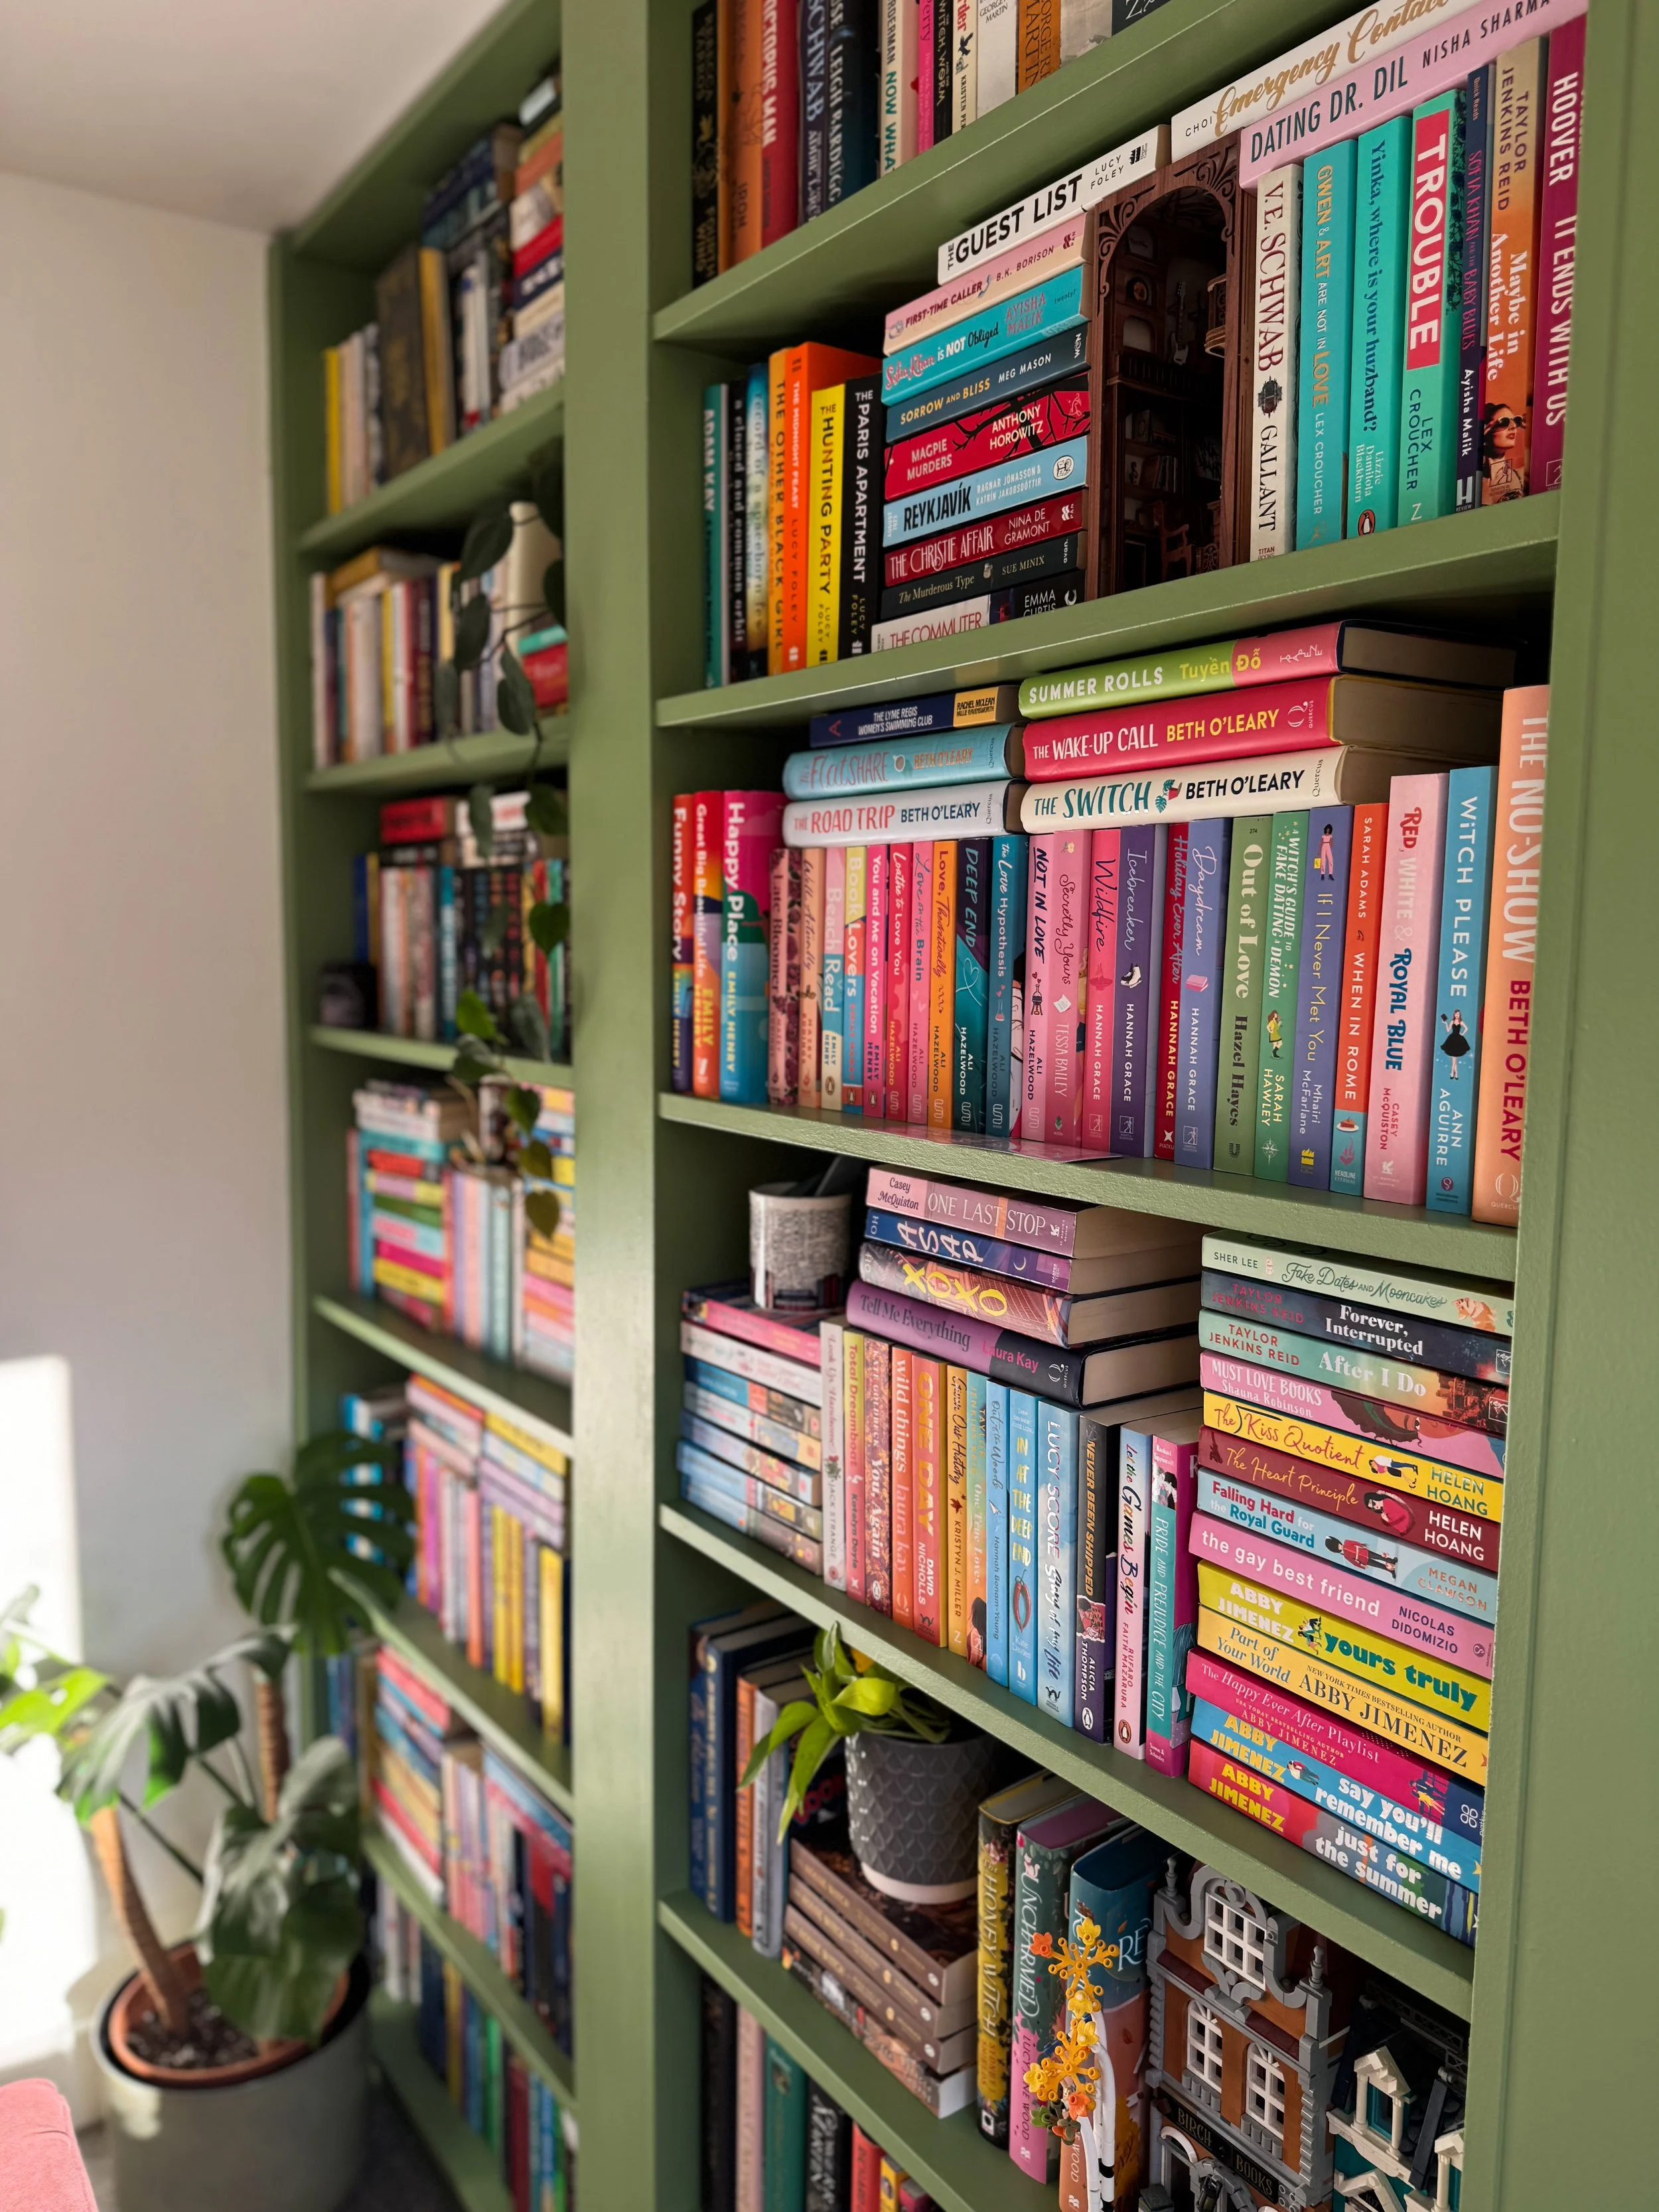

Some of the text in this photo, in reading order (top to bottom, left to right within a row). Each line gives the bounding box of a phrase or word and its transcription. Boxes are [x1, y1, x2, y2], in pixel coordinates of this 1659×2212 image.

[887, 72, 897, 115] NOW
[1185, 42, 1338, 137] CHOI Emergency
[1250, 29, 1471, 163] DATING DR. DIL NISHA
[1497, 68, 1514, 211] JENKINS REID
[1514, 91, 1527, 171] TAYLOR
[1090, 165, 1125, 190] FOLEY
[1094, 155, 1121, 176] LUCY
[955, 206, 1025, 264] GUEST
[1033, 173, 1084, 225] LIST
[1408, 133, 1447, 350] TROUBLE
[905, 281, 983, 328] FIRST-TIME CALLER
[1362, 139, 1386, 433] Yinka, where is your huzband?
[1487, 233, 1508, 382] Another Life
[1509, 249, 1528, 356] Maybe in
[1258, 180, 1286, 531] V. E. SCHWAB GALLANT
[1313, 165, 1333, 515] GWEN & ART ARE NOT IN LOVE LEX CROUCHER
[901, 378, 990, 425] SORROW AND BLISS
[991, 404, 1041, 433] ANTHONY
[911, 439, 948, 464] MAGPIE
[989, 420, 1043, 450] HOROWITZ
[853, 390, 874, 582] THE PARIS APARTMENT
[906, 454, 952, 481] MURDERS
[820, 404, 837, 594] THE HUNTING PARTY
[903, 482, 972, 532] REYKJAVÍK
[890, 525, 994, 580] THE CHRISTIE AFFAIR
[899, 555, 1045, 604] The Murderous Type SUE MINIX
[1029, 677, 1098, 704] SUMMER
[1104, 666, 1163, 691] ROLLS
[1179, 657, 1230, 682] Tuyền
[1033, 745, 1050, 760] THE
[1052, 730, 1114, 761] WAKE-UP
[1117, 725, 1159, 752] CALL
[1167, 721, 1204, 742] BETH
[1210, 709, 1279, 737] O'LEARY
[1035, 758, 1324, 819] THE SWITCH BETH O'LEARY Quercus
[724, 803, 745, 961] Happy Place
[964, 848, 978, 947] DEEP END
[1033, 847, 1048, 963] NOT IN LOVE
[1124, 848, 1147, 951] Icebreaker
[1228, 844, 1263, 1127] Out of Love Hazel Hayes
[1344, 817, 1373, 1100] SARAH ADAMS WHEN IN ROME
[1261, 1068, 1271, 1127] HAWLEY
[1274, 1074, 1284, 1123] SARAH
[1435, 1087, 1449, 1166] AGUIRRE
[1451, 1109, 1462, 1148] ANN
[928, 1193, 1045, 1236] ONE LAST STOP
[903, 1263, 1007, 1316] XOXO
[1214, 1252, 1447, 1309] SHER LEE Fake Dates AND Mooncakes
[861, 1294, 971, 1351] Tell Me Everything
[1325, 1318, 1423, 1356] Interrupted
[1340, 1304, 1407, 1338] Forever,
[1319, 1351, 1426, 1397] After I Do
[1047, 1420, 1060, 1559] LUCY SCORE
[1085, 1440, 1095, 1596] NEVER BEEN SHIPPED
[1212, 1482, 1295, 1523] Falling Hard
[1230, 1504, 1315, 1549] Royal Guard
[1424, 1529, 1484, 1561] HOANG
[1429, 1511, 1482, 1540] HELEN
[917, 1542, 926, 1605] NICHOLLS
[1201, 1531, 1380, 1618] the gay best friend
[1391, 1620, 1458, 1654] DIDOMIZIO
[1399, 1606, 1455, 1636] NICOLAS
[1324, 1631, 1478, 1712] yours truly
[1299, 1675, 1467, 1768] ABBY JIMENEZ
[1338, 1778, 1374, 1809] say
[1315, 1787, 1461, 1879] remember me
[1334, 1826, 1421, 1884] just for
[1315, 1837, 1442, 1920] the summer
[1177, 2110, 1273, 2197] BIRCH BOOKS
